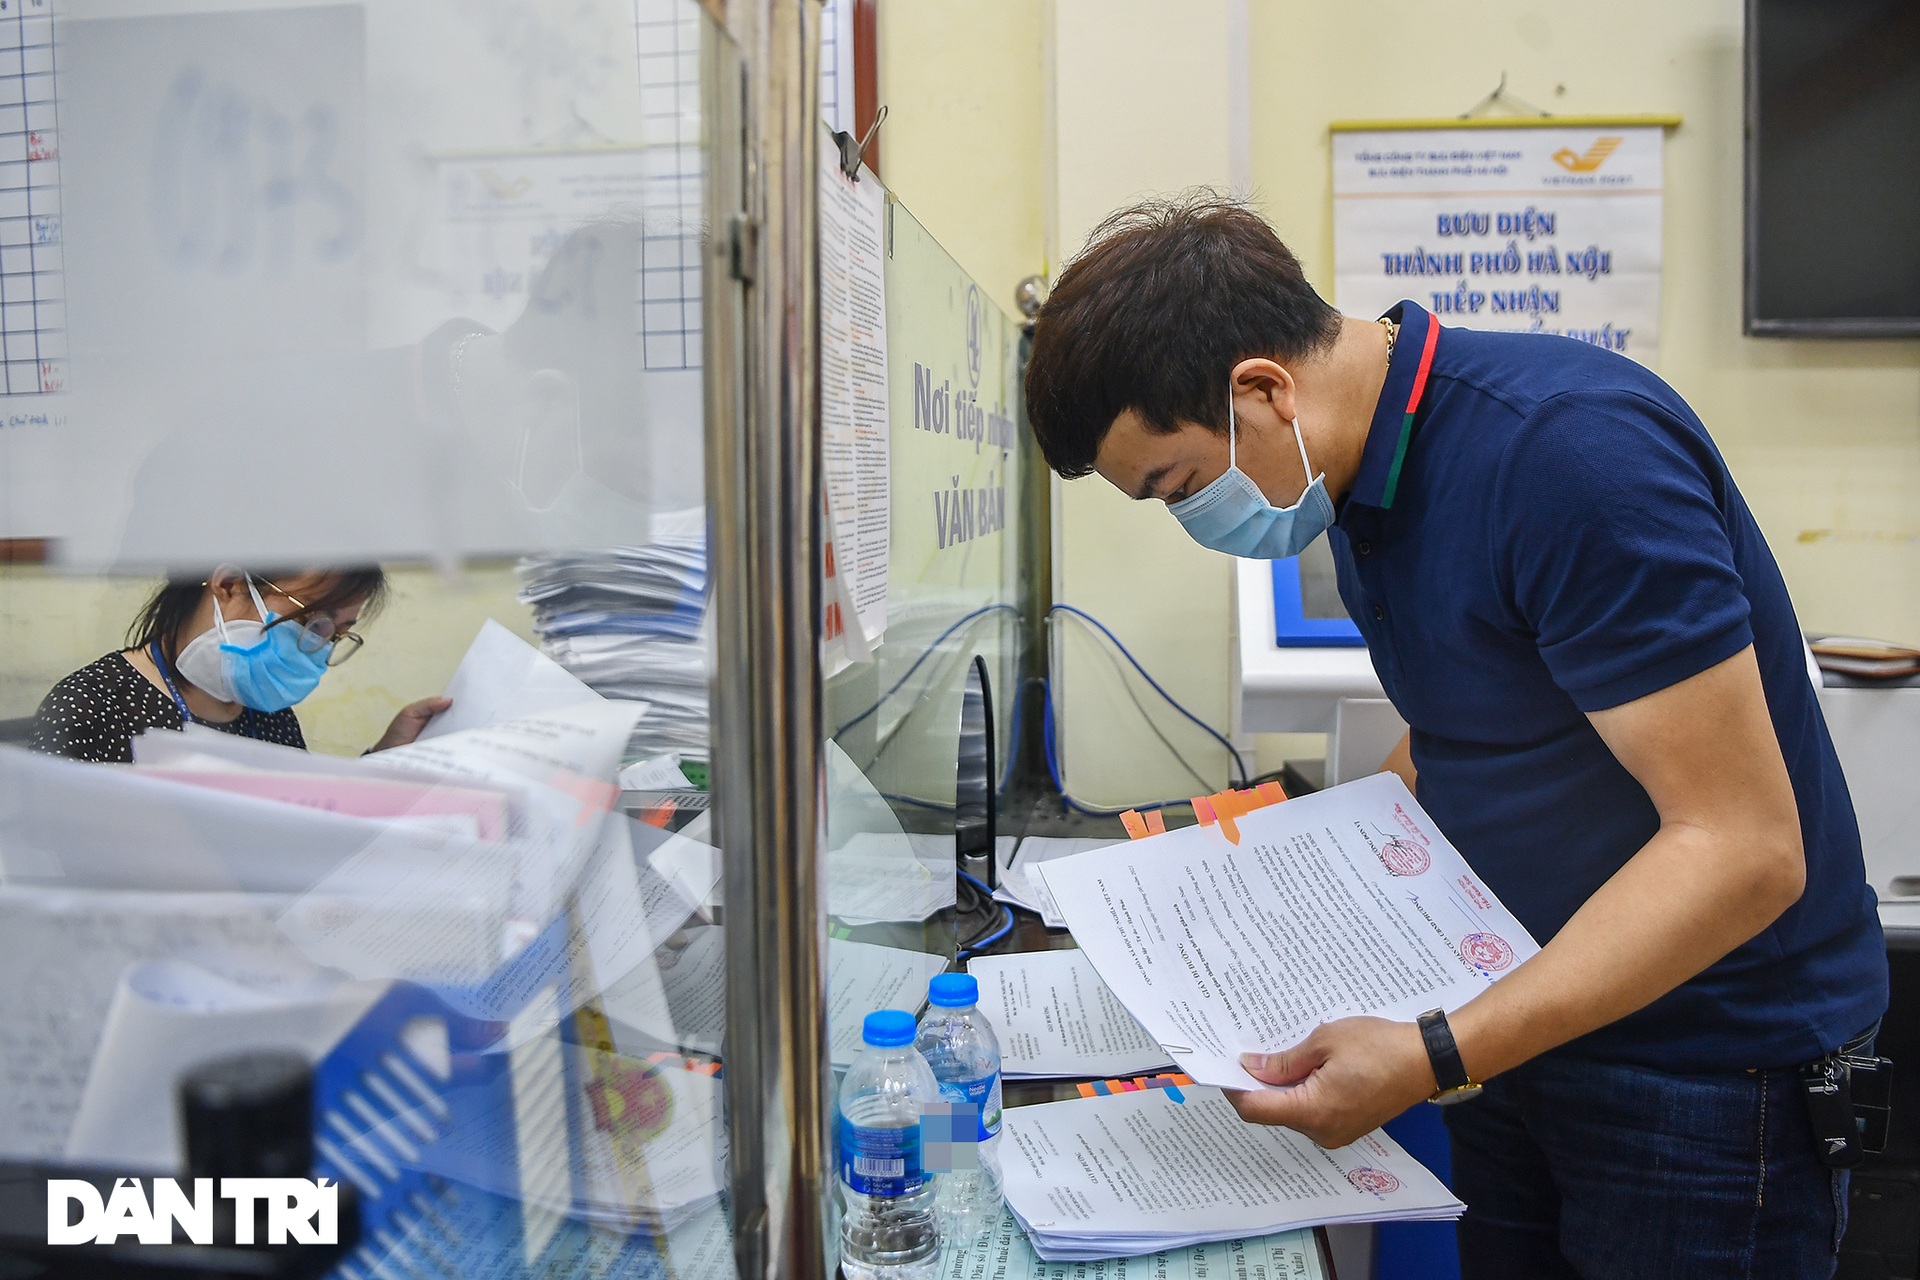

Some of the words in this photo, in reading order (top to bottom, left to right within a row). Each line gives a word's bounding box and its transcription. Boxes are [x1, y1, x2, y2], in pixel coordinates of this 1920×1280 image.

[1437, 211, 1489, 236] BƯU
[1382, 246, 1462, 275] THÀNH
[1470, 240, 1520, 274] PHỐ
[1528, 247, 1560, 275] HÀ
[1566, 246, 1610, 280] NỘI
[1430, 279, 1485, 313] TIẾP
[1491, 285, 1560, 316] NHẬN
[913, 362, 950, 434] Nơi
[955, 389, 984, 454] tiếp
[934, 475, 974, 550] VĂN
[1177, 943, 1195, 969] ĐƯỜNG
[1196, 980, 1210, 998] GIẤY
